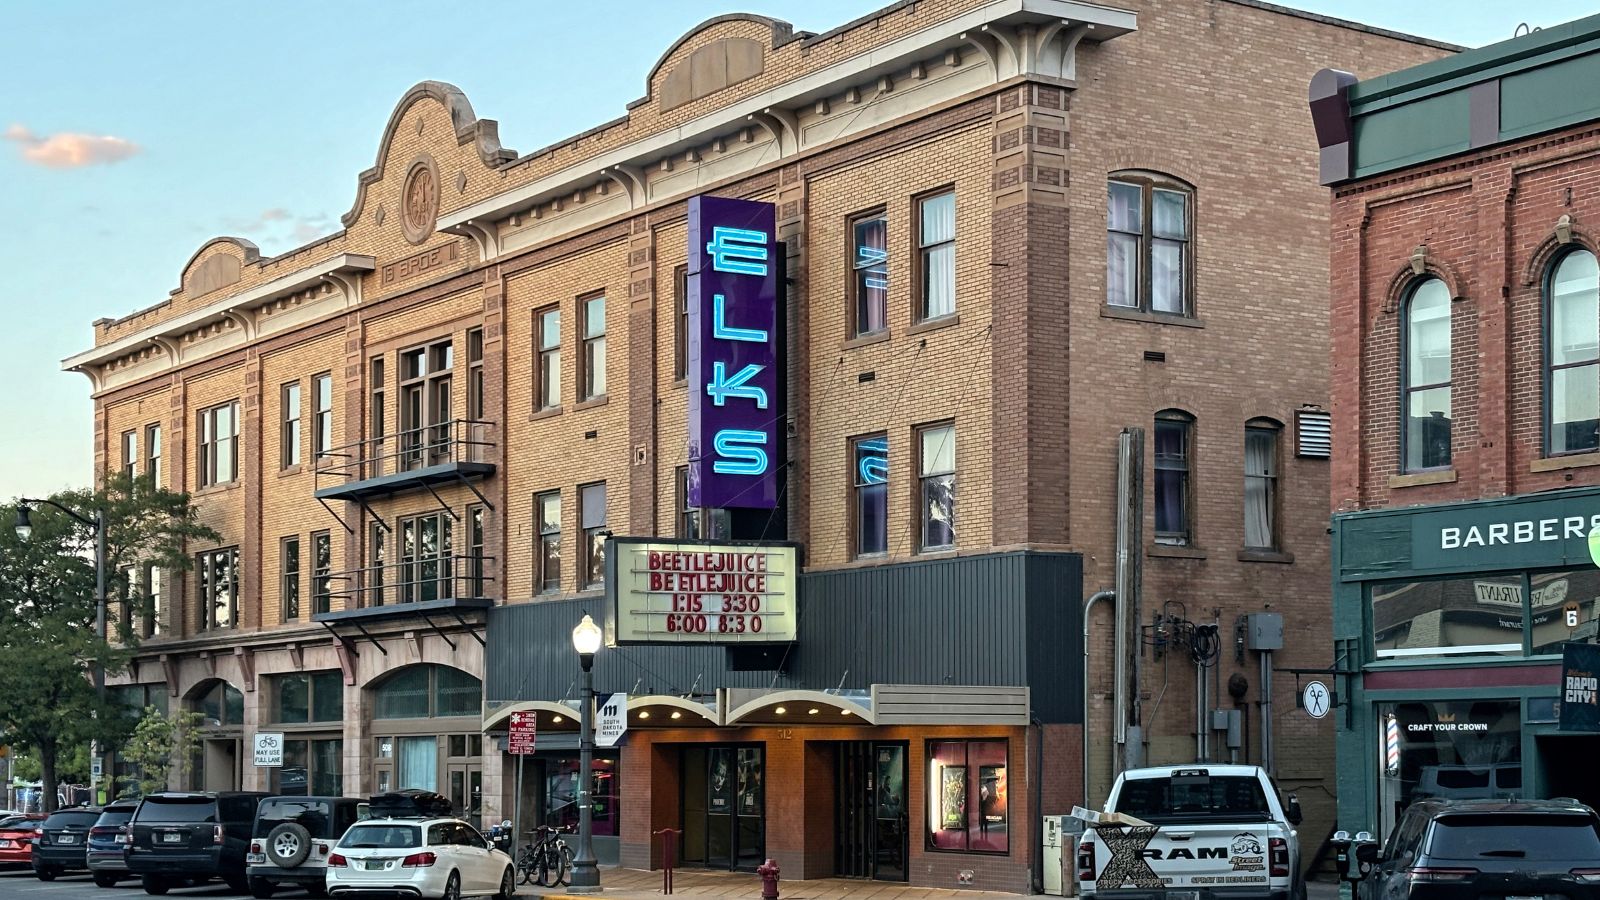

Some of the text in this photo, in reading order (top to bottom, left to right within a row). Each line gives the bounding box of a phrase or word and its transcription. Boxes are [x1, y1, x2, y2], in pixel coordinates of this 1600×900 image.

[706, 226, 769, 476] ELKS
[649, 551, 766, 573] BEETLEJUICE
[672, 593, 760, 613] 1:15 3:30
[667, 613, 707, 633] 6:00
[1566, 676, 1598, 691] RAPID
[1407, 723, 1489, 732] CRAFT YOUR CROWN
[1134, 847, 1228, 860] RAM
[1229, 856, 1264, 865] Street
